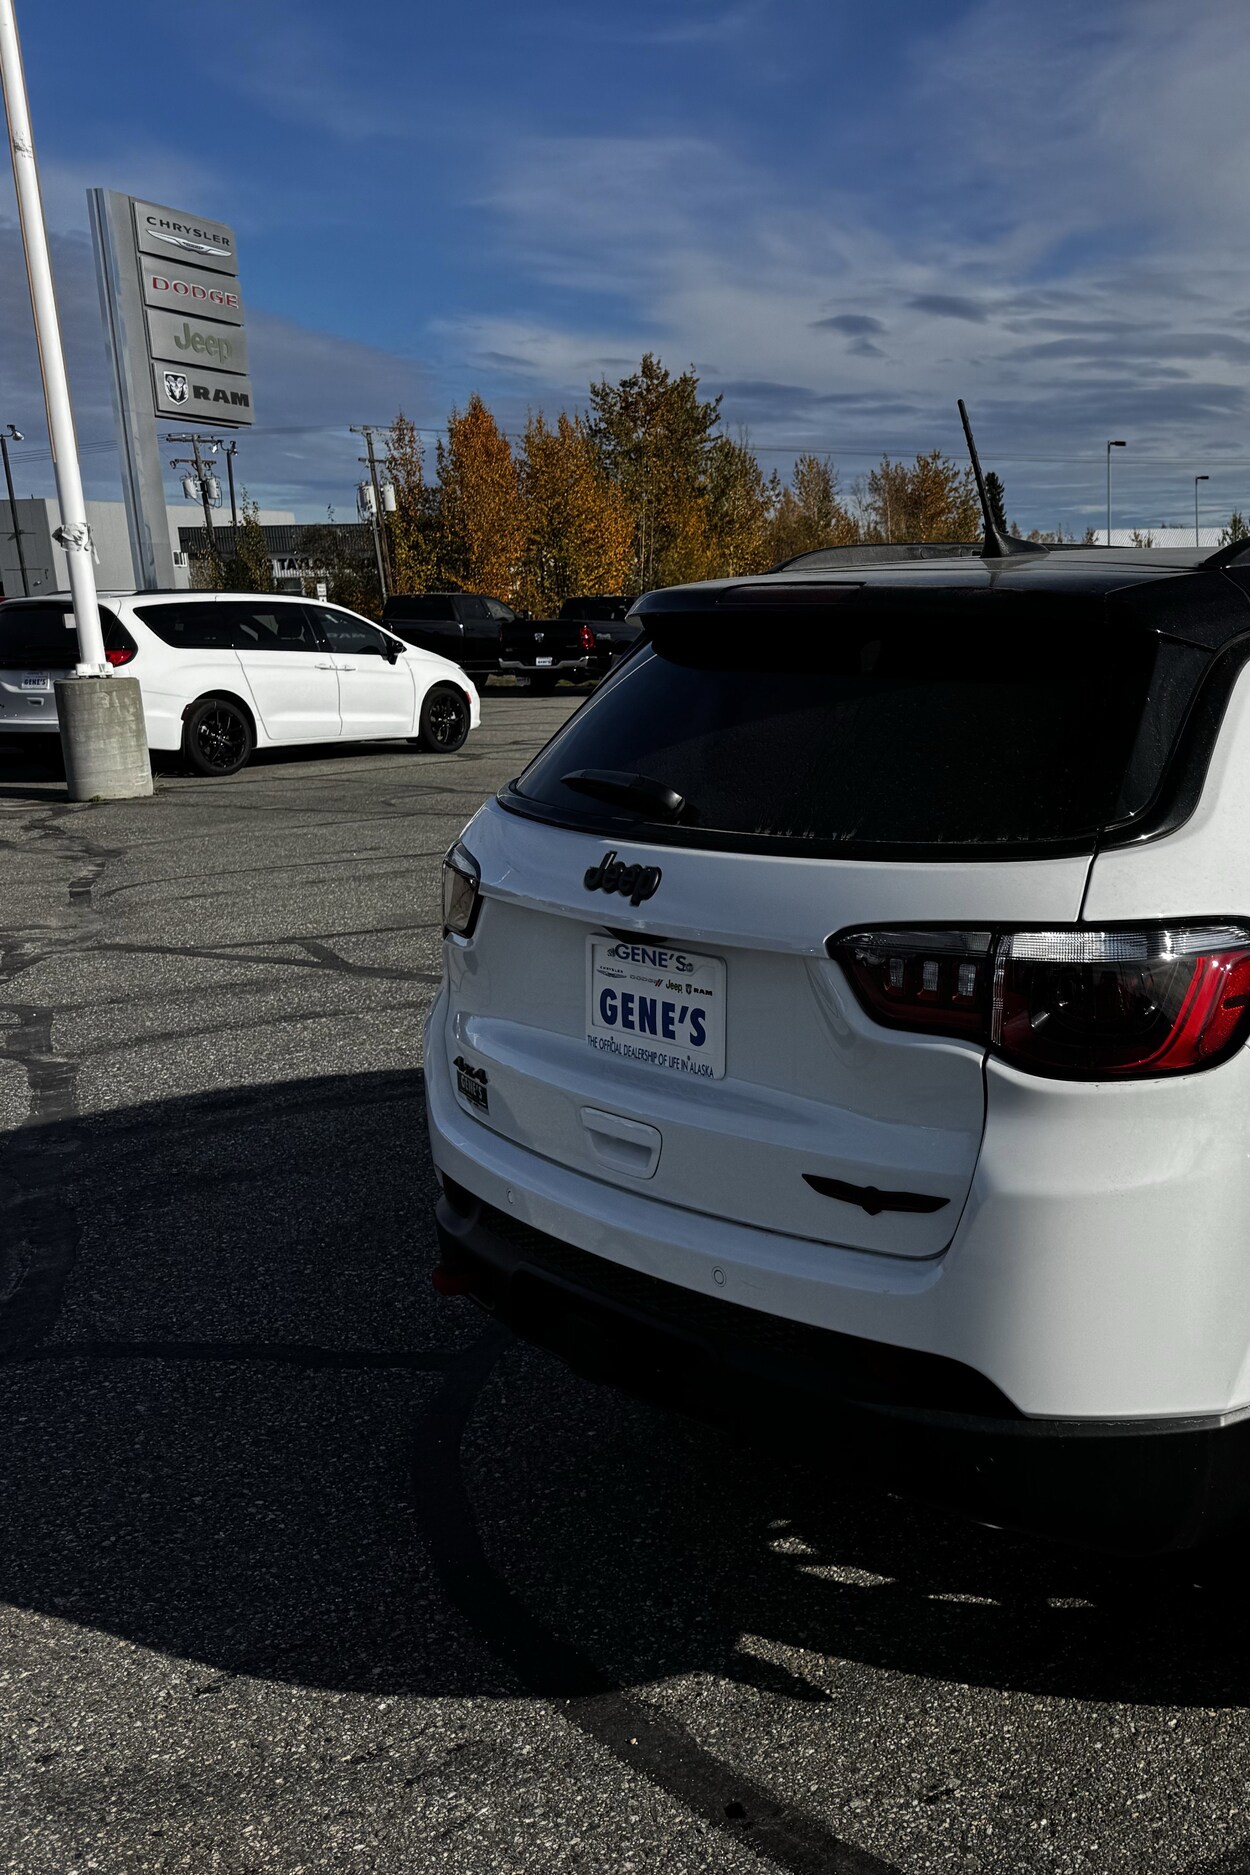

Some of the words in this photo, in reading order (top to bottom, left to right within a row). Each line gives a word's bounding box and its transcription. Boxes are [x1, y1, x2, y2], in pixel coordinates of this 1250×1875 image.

[146, 216, 231, 247] CHRYSLER
[152, 276, 239, 309] DODGE
[174, 322, 232, 364] Jeep
[192, 384, 250, 408] RAM
[584, 850, 662, 907] Jeep
[615, 943, 688, 972] GENE'S
[665, 979, 683, 993] Jeep
[693, 987, 713, 997] RAM
[600, 988, 706, 1047] GENE'S
[587, 1034, 598, 1049] THE
[599, 1038, 622, 1055] OFFICIAL
[623, 1044, 657, 1063] DEALERSHIP
[658, 1053, 667, 1066] OF
[668, 1056, 680, 1070] LIFE
[681, 1059, 688, 1072] IN
[689, 1062, 715, 1079] ALASKA
